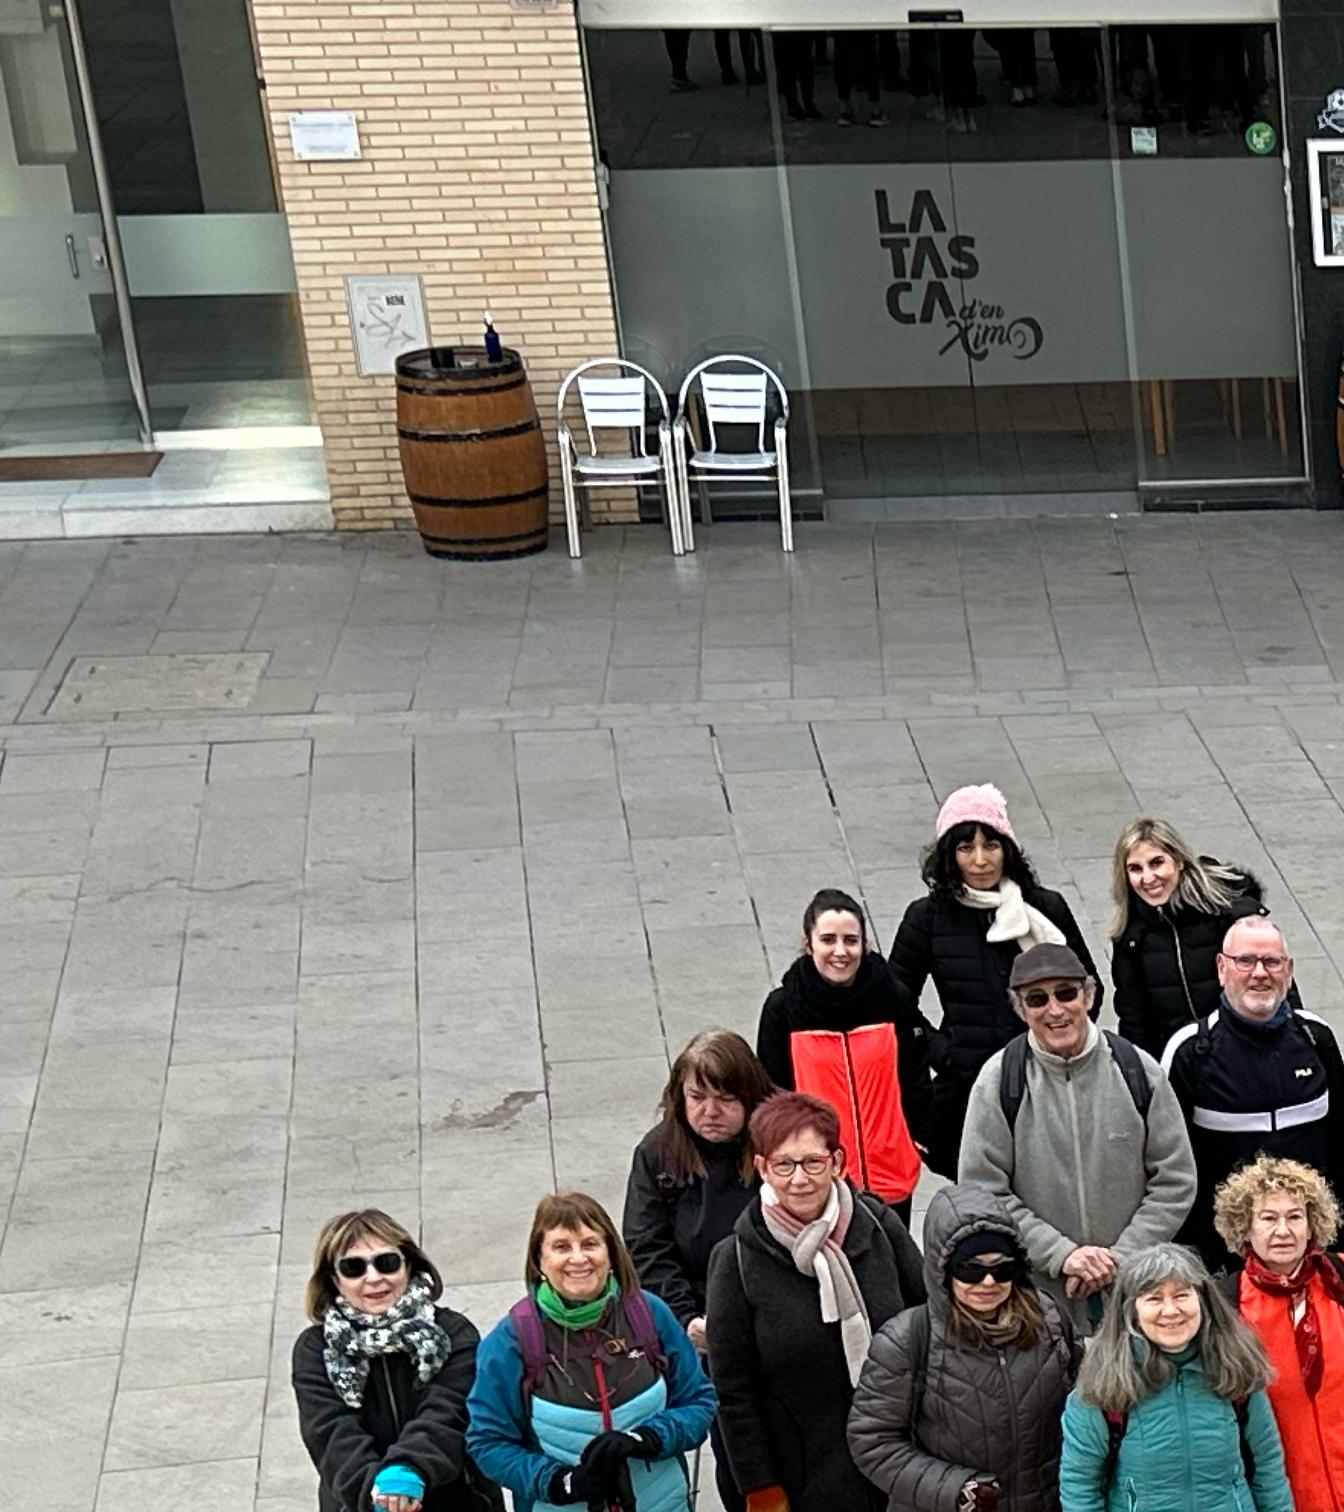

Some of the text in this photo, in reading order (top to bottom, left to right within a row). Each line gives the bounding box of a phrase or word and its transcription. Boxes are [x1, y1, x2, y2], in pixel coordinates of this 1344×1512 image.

[875, 189, 946, 234] LA
[880, 236, 980, 280] TAS
[886, 281, 1004, 324] CA d'en
